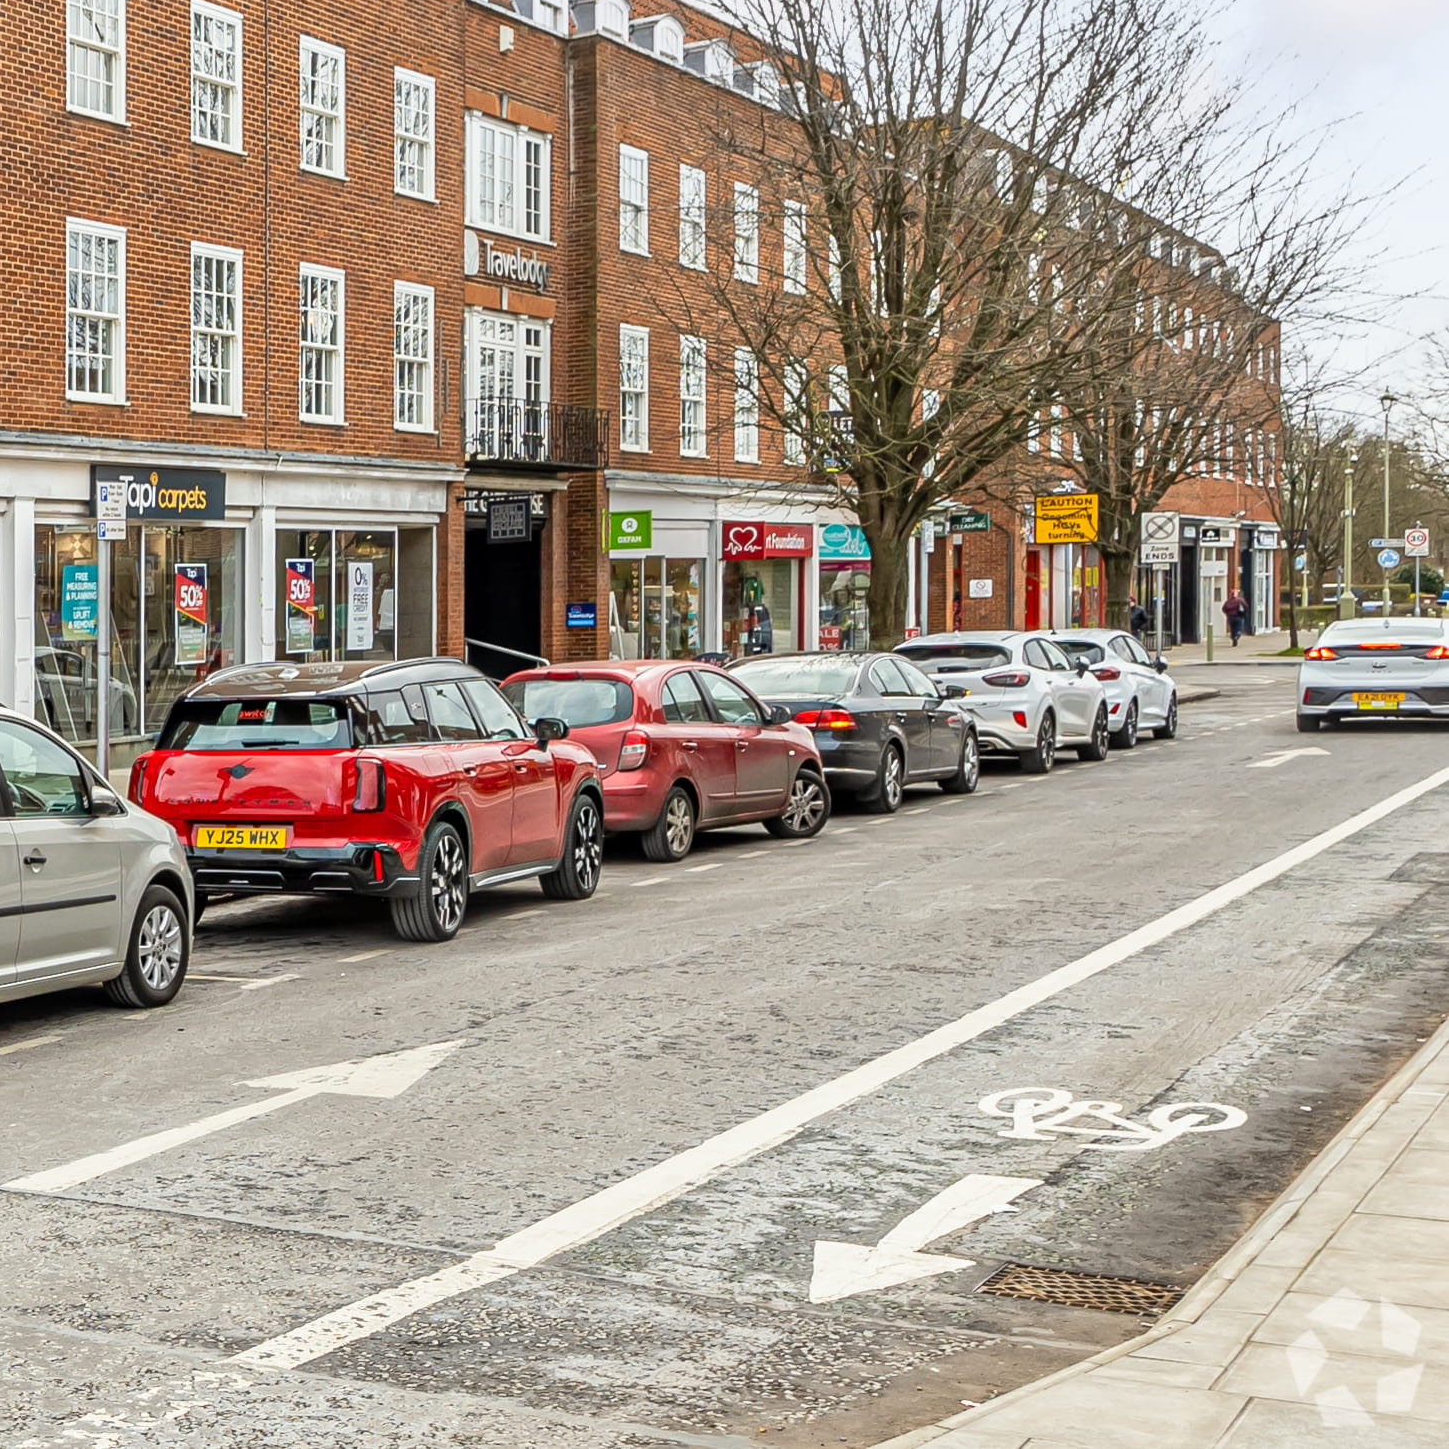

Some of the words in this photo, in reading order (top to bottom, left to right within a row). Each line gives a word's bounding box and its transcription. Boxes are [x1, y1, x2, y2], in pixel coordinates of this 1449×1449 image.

[118, 471, 159, 516] Tapi
[158, 485, 207, 513] carpets
[1041, 498, 1093, 508] CAUTION
[1052, 521, 1081, 530] HGVs
[617, 535, 642, 544] OXFAM
[771, 533, 805, 550] Foundation
[1048, 531, 1085, 540] turning
[1410, 535, 1424, 543] 30
[1145, 552, 1175, 560] ENDS
[354, 566, 369, 586] 0%
[289, 579, 311, 601] 50%
[179, 585, 204, 608] 50%
[353, 593, 369, 605] FREE
[206, 830, 245, 845] YJ25
[249, 830, 280, 845] WHX
